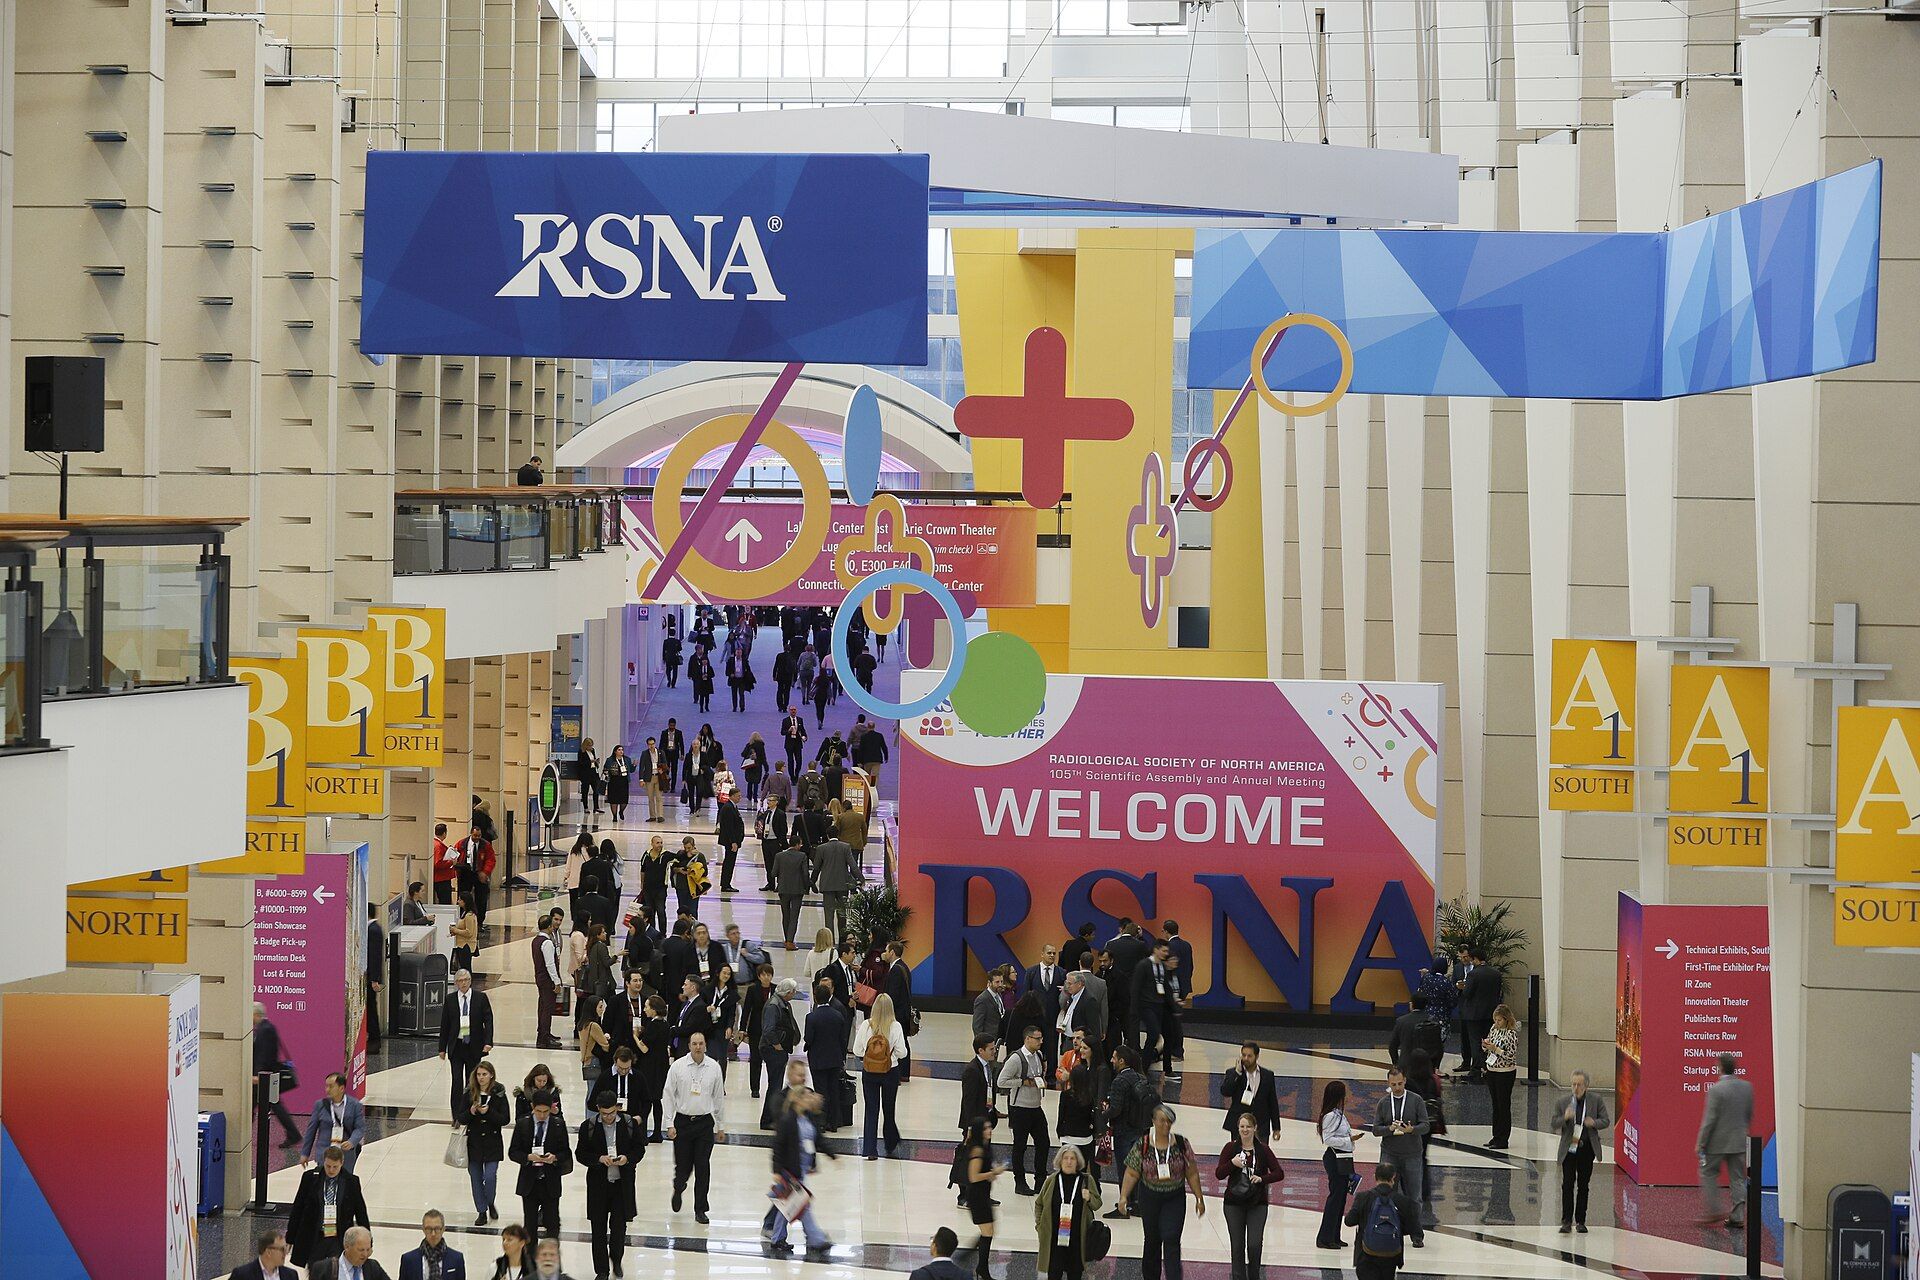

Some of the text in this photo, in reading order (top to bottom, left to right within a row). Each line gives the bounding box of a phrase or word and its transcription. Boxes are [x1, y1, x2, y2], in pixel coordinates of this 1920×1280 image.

[832, 522, 864, 534] Center
[905, 523, 923, 535] Arie
[926, 524, 957, 535] Crown
[959, 524, 997, 536] Theater
[829, 559, 858, 574] E0,
[934, 563, 954, 573] oms
[797, 577, 847, 590] Connecti
[951, 579, 985, 592] Center
[384, 734, 439, 751] ORTH
[1049, 754, 1325, 772] RADIOLOGICAL SOCIETY OF NORTH AMERICA
[1085, 770, 1141, 782] Scientific
[1146, 772, 1202, 786] Assembly
[1206, 774, 1227, 784] and
[1232, 775, 1272, 786] Annual
[1277, 777, 1326, 789] Meeting
[1553, 777, 1630, 795] SOUTH
[973, 786, 1325, 847] WELCOME
[245, 832, 300, 852] RTH
[1673, 826, 1763, 847] SOUTH
[256, 888, 264, 898] B,
[1841, 899, 1920, 923] SOUT
[66, 910, 180, 937] NORTH
[274, 921, 307, 930] Showcase
[260, 937, 280, 948] Badge
[281, 937, 307, 948] Pick-up
[918, 863, 1436, 1014] RSNA
[1685, 945, 1718, 955] Technical
[1719, 945, 1750, 956] Exhibits,
[253, 952, 307, 962] nformation Desk
[1685, 963, 1721, 972] First-Time
[1723, 963, 1754, 972] Exhibitor
[263, 969, 306, 978] Lost & Found
[257, 984, 263, 994] &
[264, 985, 283, 994] N200
[284, 985, 306, 995] Rooms
[1684, 979, 1712, 989] IR Zone
[276, 1001, 293, 1010] Food
[1684, 997, 1749, 1006] Innovation Theater
[1684, 1014, 1738, 1023] Publishers Row
[1684, 1031, 1737, 1040] Recruiters Row
[1683, 1048, 1705, 1058] RSNA
[1683, 1065, 1746, 1077] Startup Shase
[1683, 1082, 1701, 1092] Food
